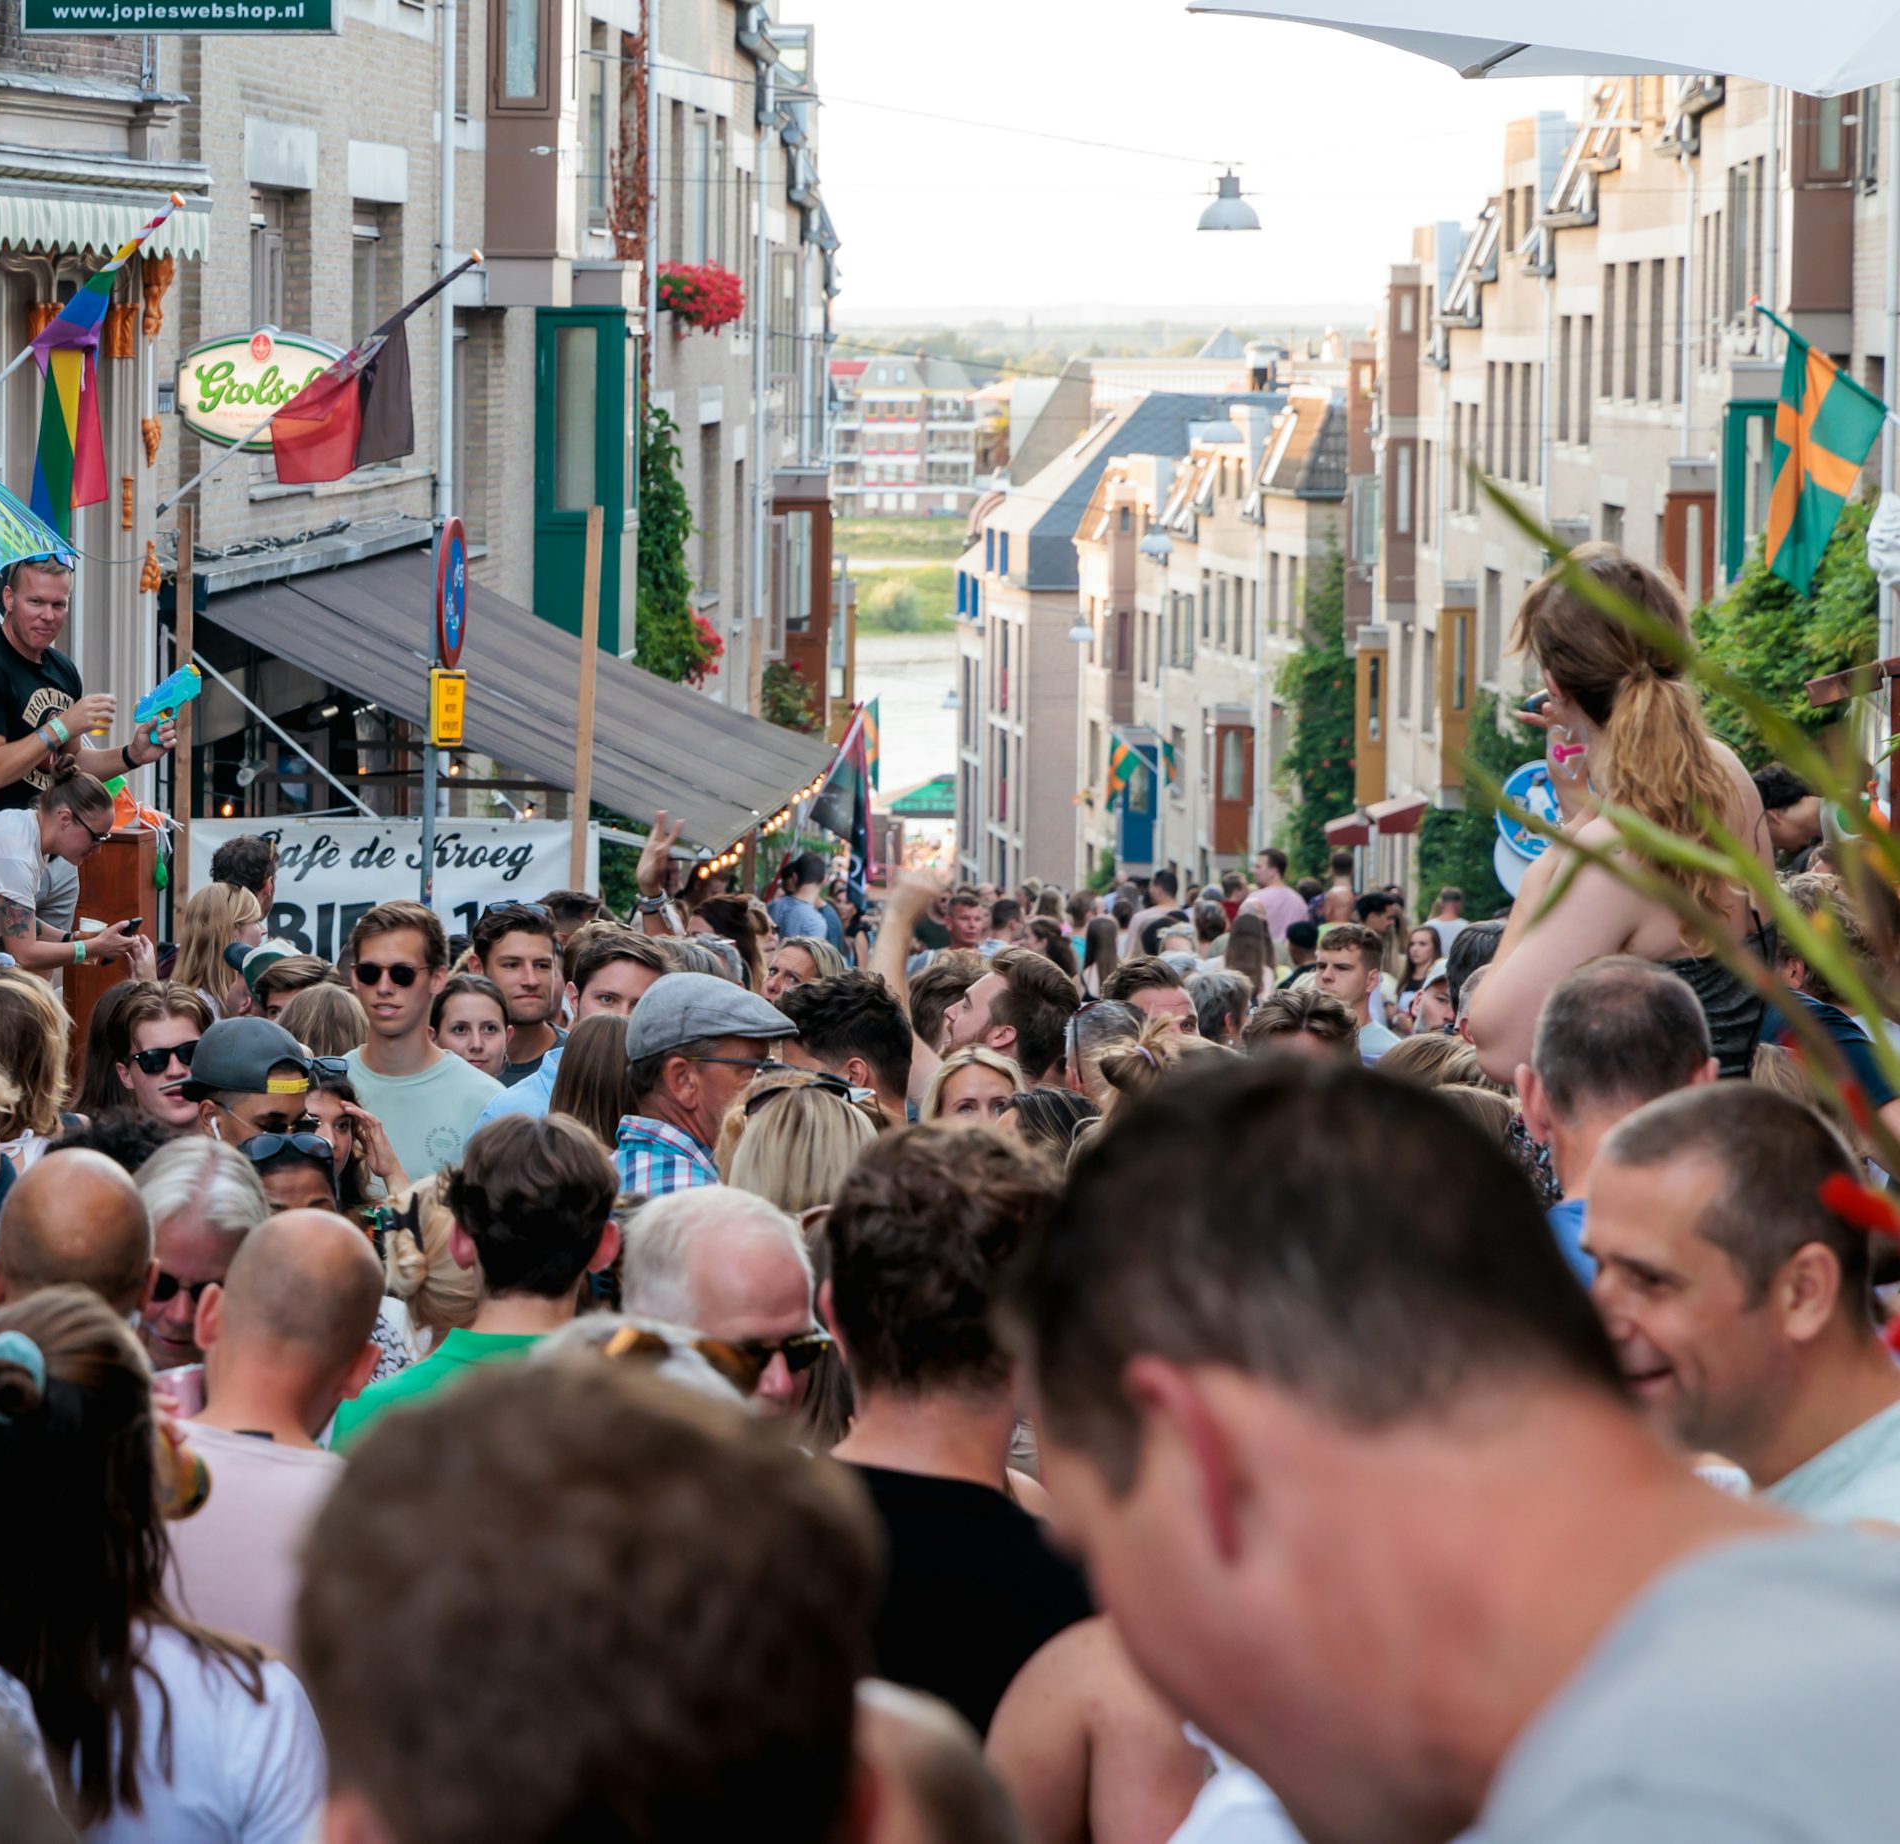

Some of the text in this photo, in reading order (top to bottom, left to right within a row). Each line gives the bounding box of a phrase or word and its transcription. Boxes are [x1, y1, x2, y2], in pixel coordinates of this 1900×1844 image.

[52, 3, 306, 21] www.jopieswebshop.nl
[350, 833, 397, 868] de
[406, 827, 534, 882] Kroeg
